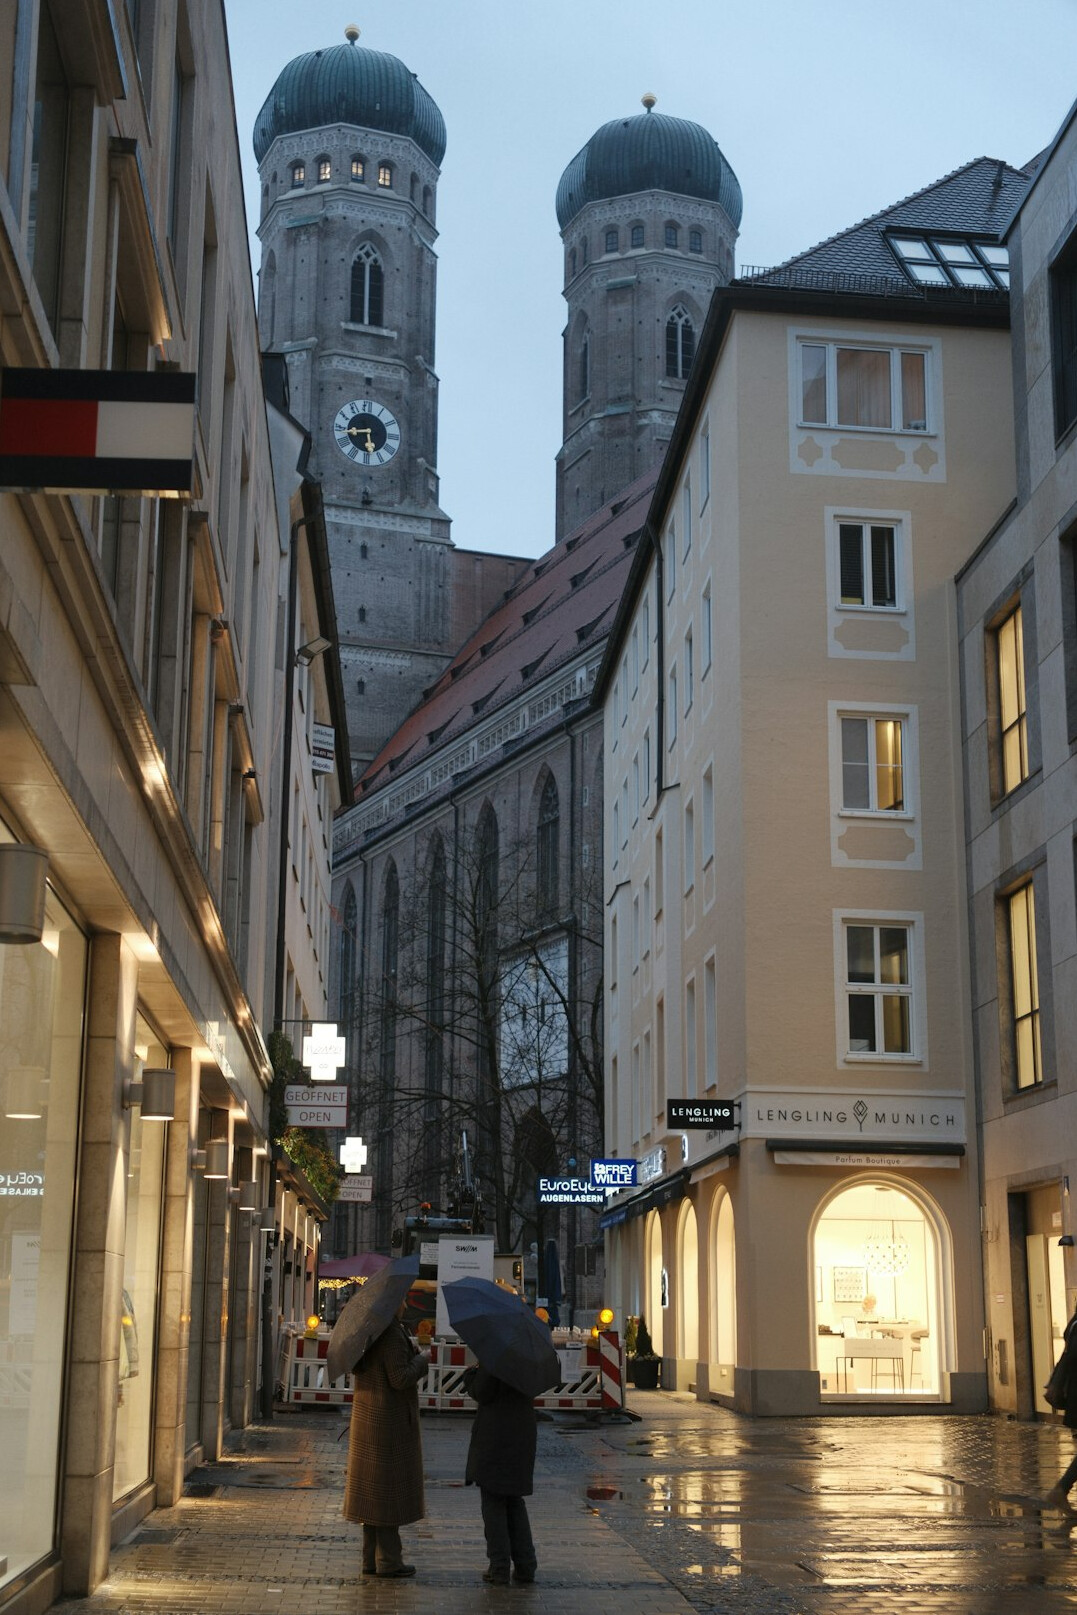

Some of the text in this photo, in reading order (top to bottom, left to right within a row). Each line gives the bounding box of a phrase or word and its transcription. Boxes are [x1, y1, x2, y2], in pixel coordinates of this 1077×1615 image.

[286, 1090, 346, 1101] GEÖFFNET
[299, 1111, 331, 1122] OPEN
[672, 1107, 731, 1117] LENGLING
[757, 1110, 955, 1126] LENGLING MUNICH
[835, 1155, 901, 1166] Parfum Boutique
[605, 1164, 635, 1175] FREY
[594, 1173, 633, 1184] WILLE
[342, 1190, 363, 1199] OPEN
[540, 1194, 604, 1203] AUGENLASERN
